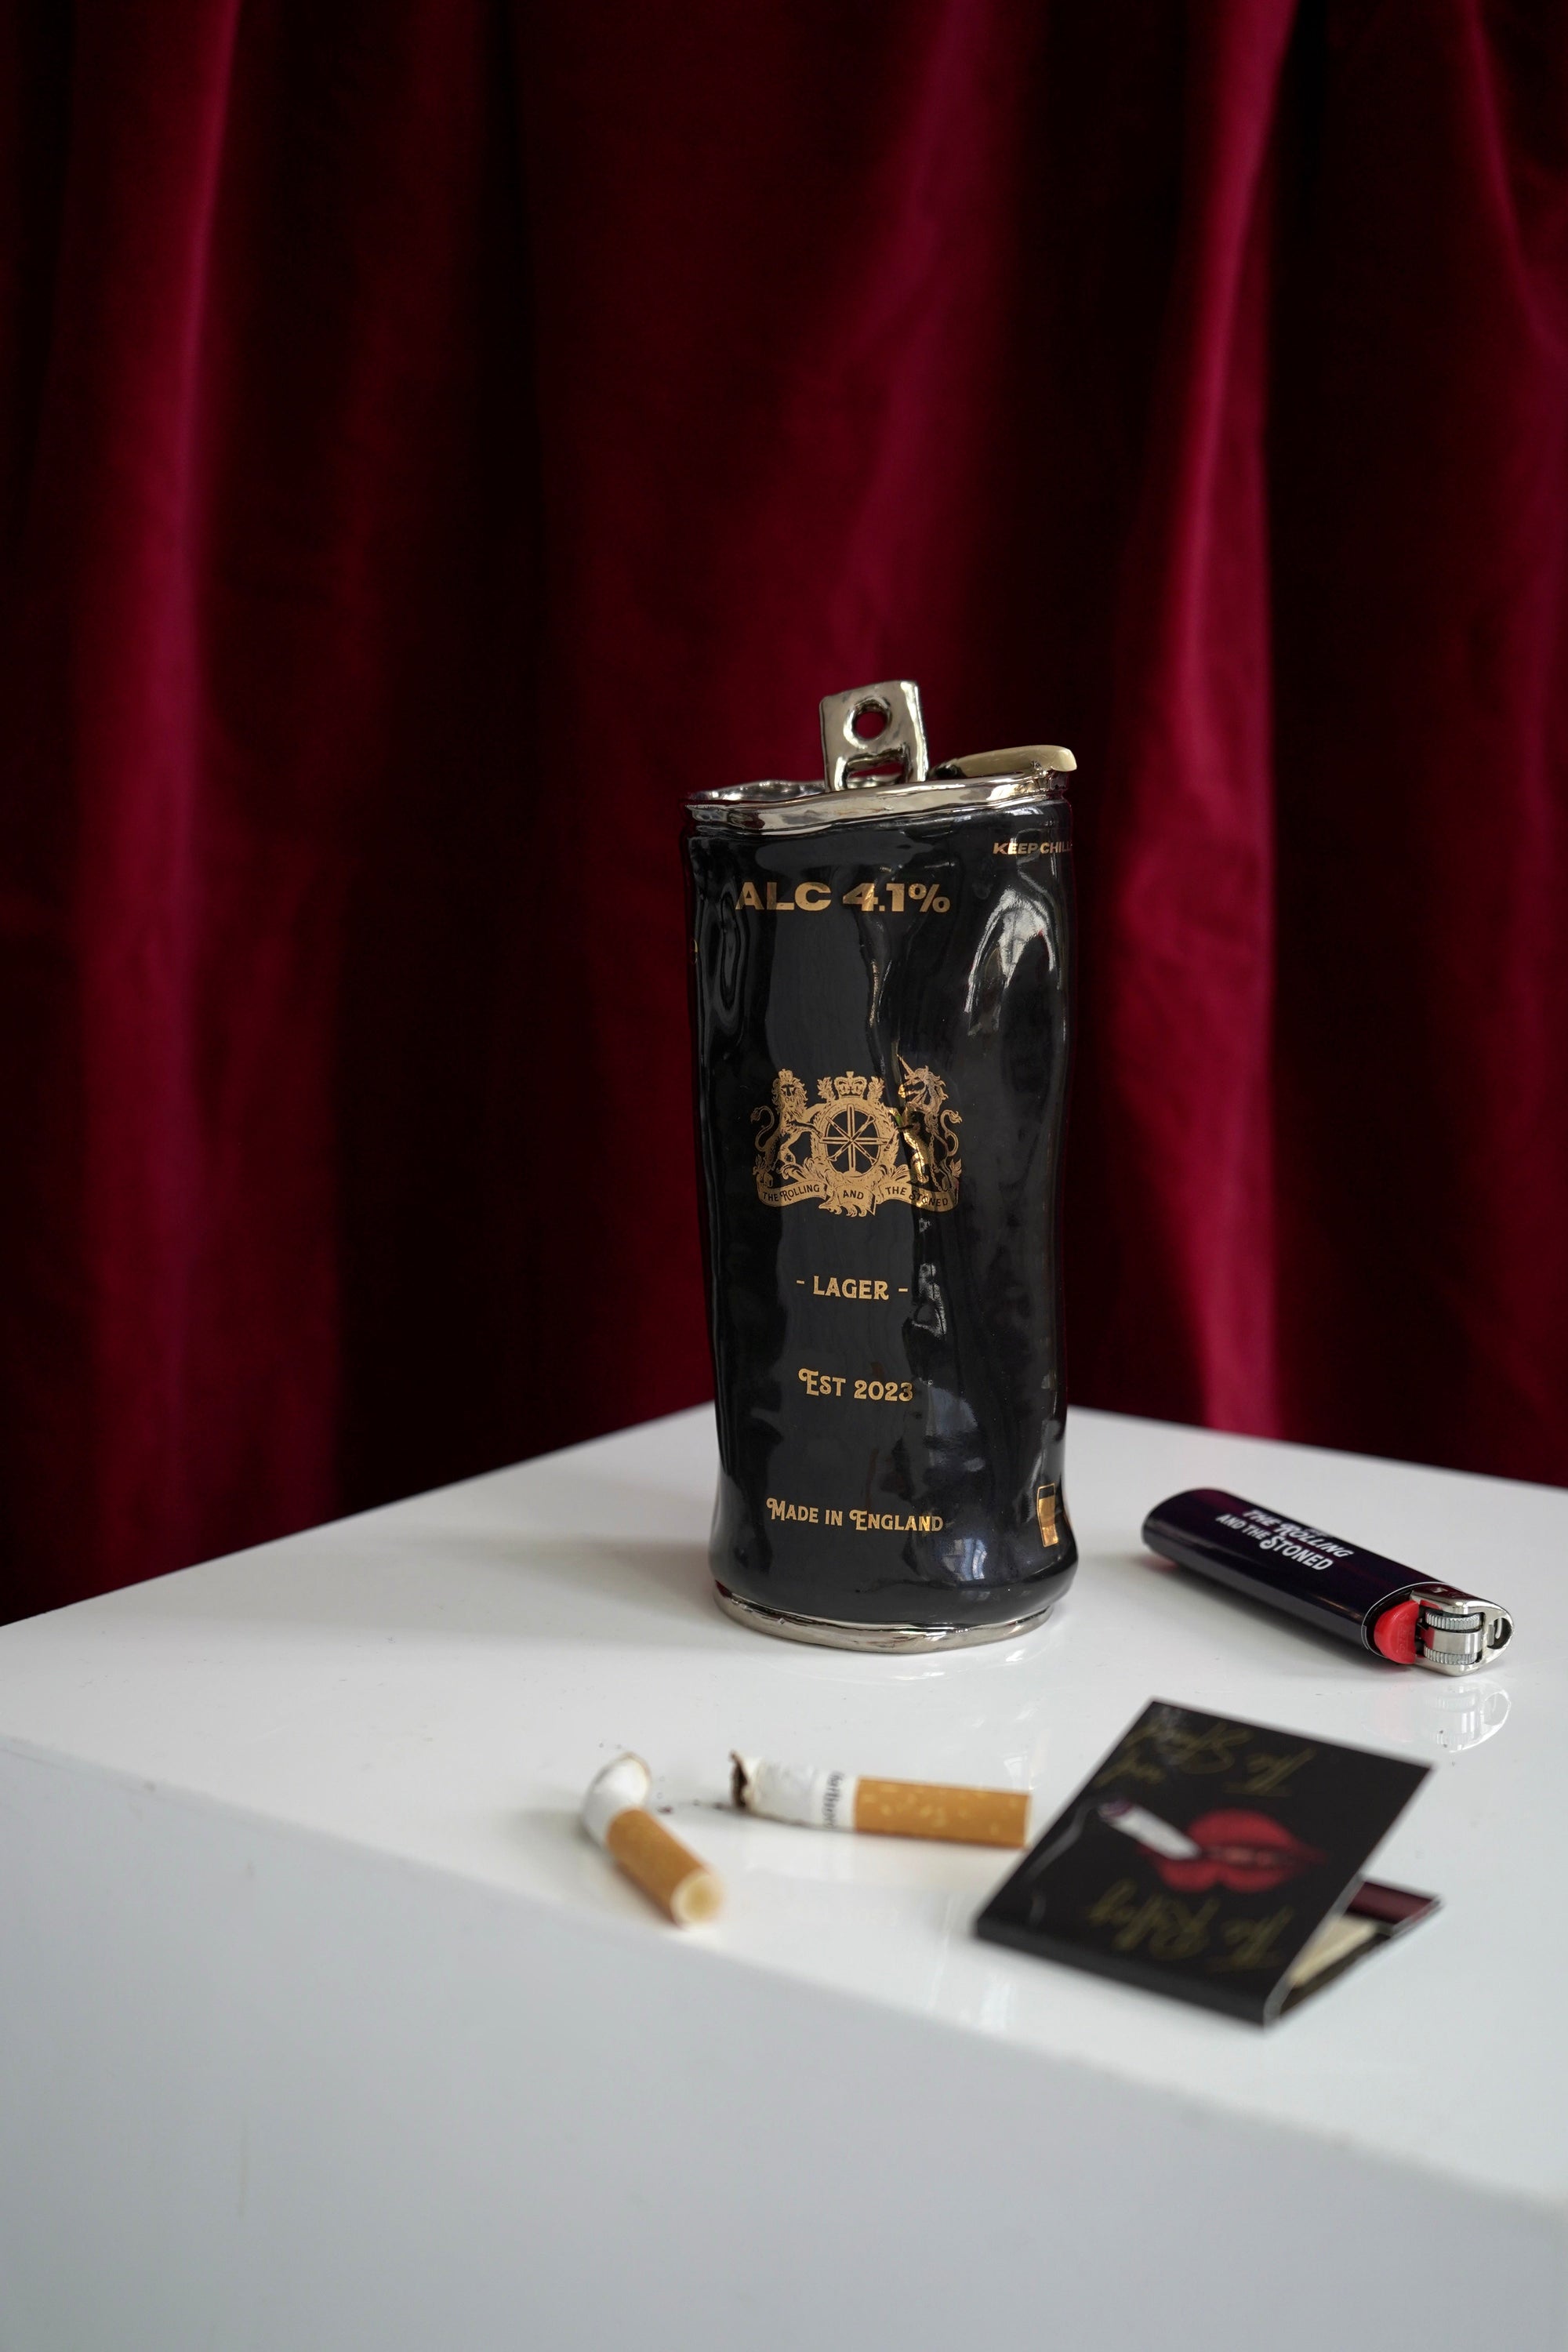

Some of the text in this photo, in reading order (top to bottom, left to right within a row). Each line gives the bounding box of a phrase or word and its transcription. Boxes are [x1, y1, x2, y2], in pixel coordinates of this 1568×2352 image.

[993, 843, 1039, 855] KEEP
[735, 882, 951, 913] ALC 4.1%
[763, 1184, 949, 1207] THE ROLLING AND THE STONED
[813, 1275, 890, 1301] LAGER
[854, 1380, 914, 1402] 2023
[766, 1497, 944, 1533] MADE IN ENGLAND
[1215, 1514, 1334, 1570] AND THE STONED
[1243, 1509, 1354, 1558] THE ROLLING
